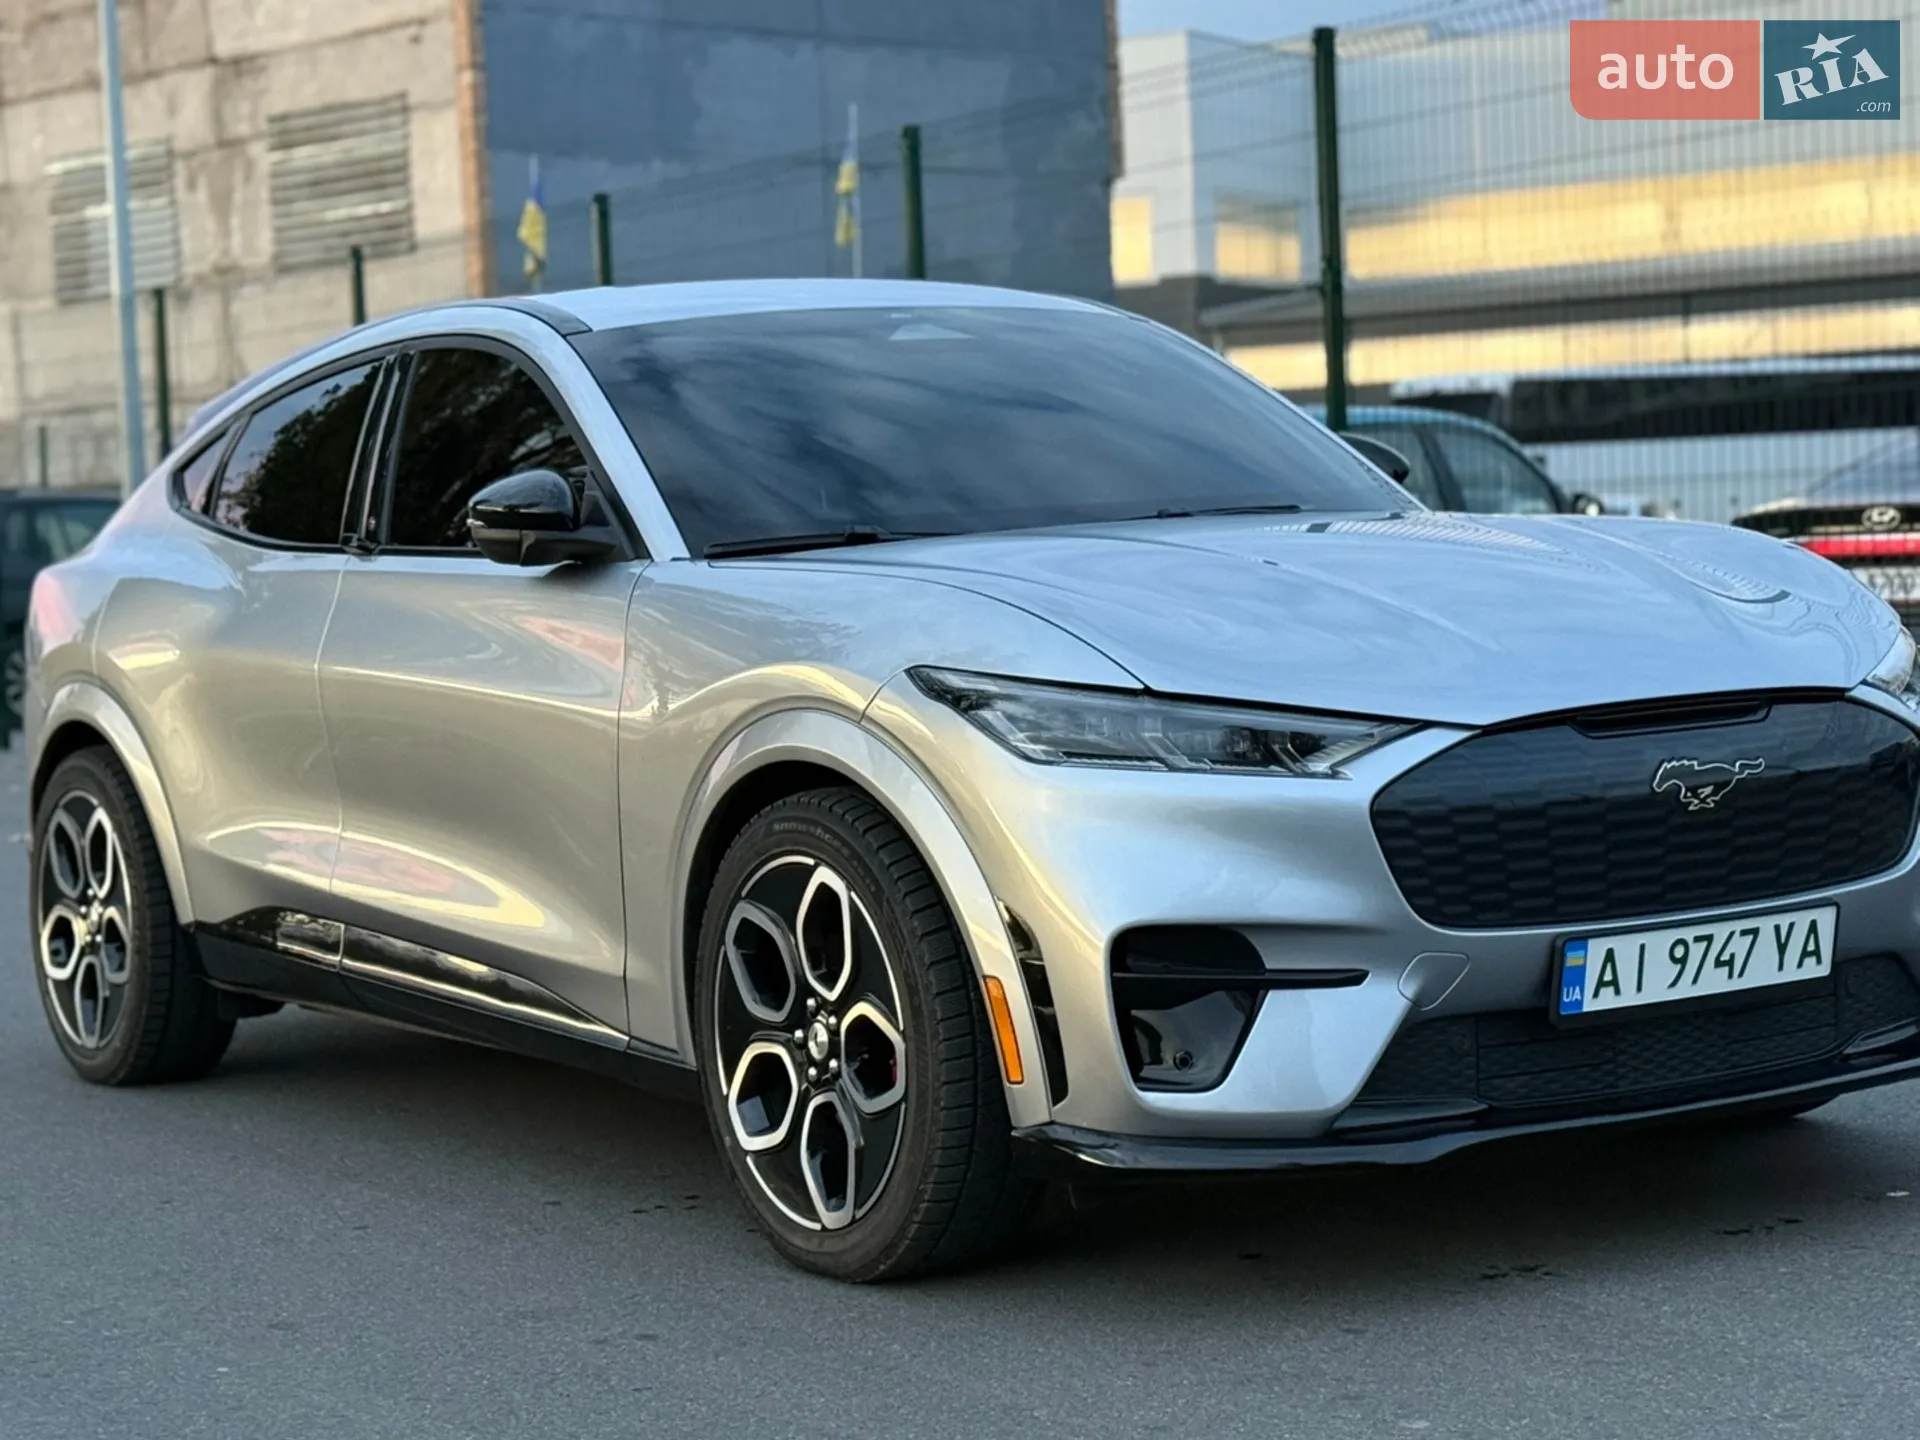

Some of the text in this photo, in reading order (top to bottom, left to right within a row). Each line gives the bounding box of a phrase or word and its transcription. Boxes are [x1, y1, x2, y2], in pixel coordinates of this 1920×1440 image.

[1667, 926, 1761, 989] 9747
[1773, 918, 1823, 973] YA
[1563, 985, 1582, 1002] UA
